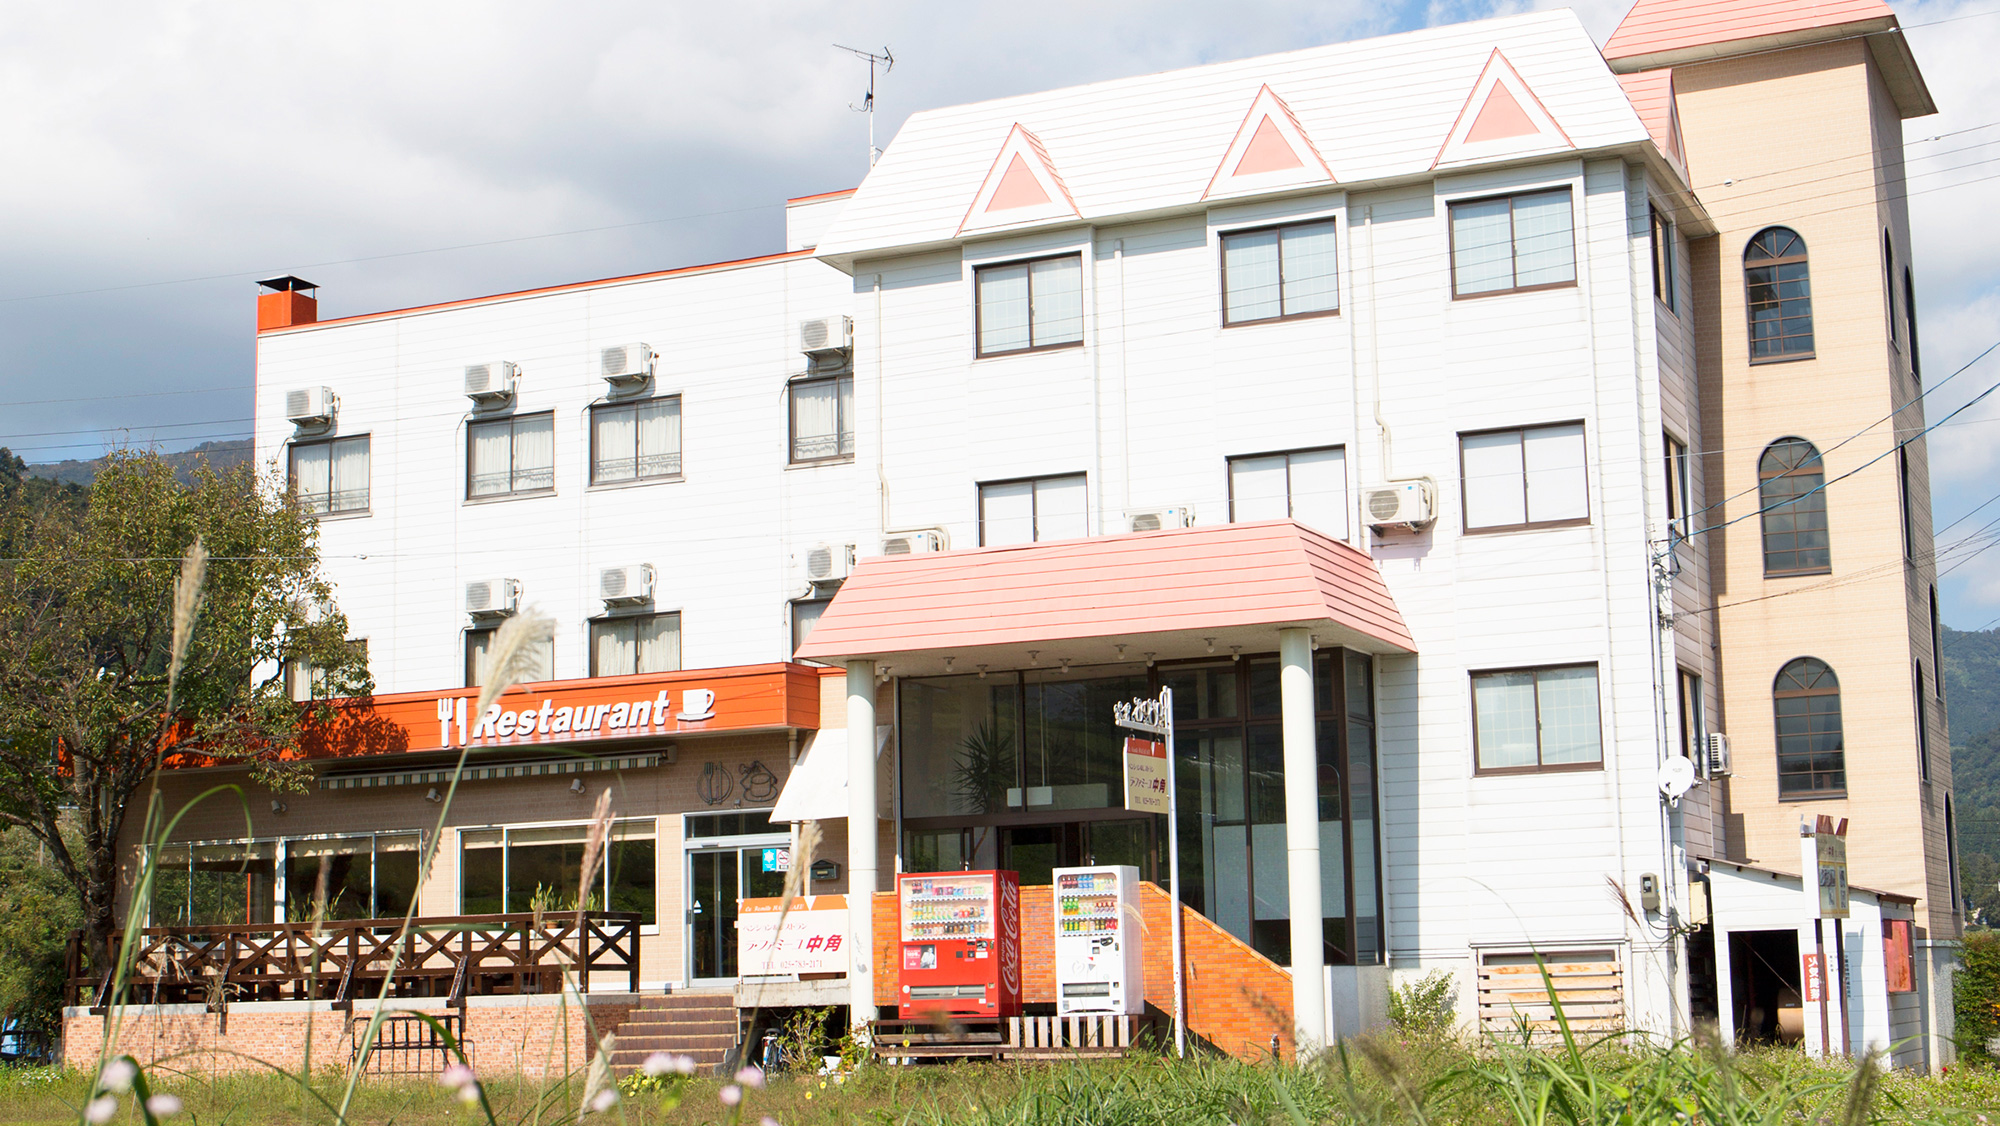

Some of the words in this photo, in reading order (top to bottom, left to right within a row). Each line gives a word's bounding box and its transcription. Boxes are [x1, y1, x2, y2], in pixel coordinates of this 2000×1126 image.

[473, 690, 670, 739] Restaurant
[1001, 873, 1019, 995] Coca-Cola
[761, 961, 775, 970] TEL
